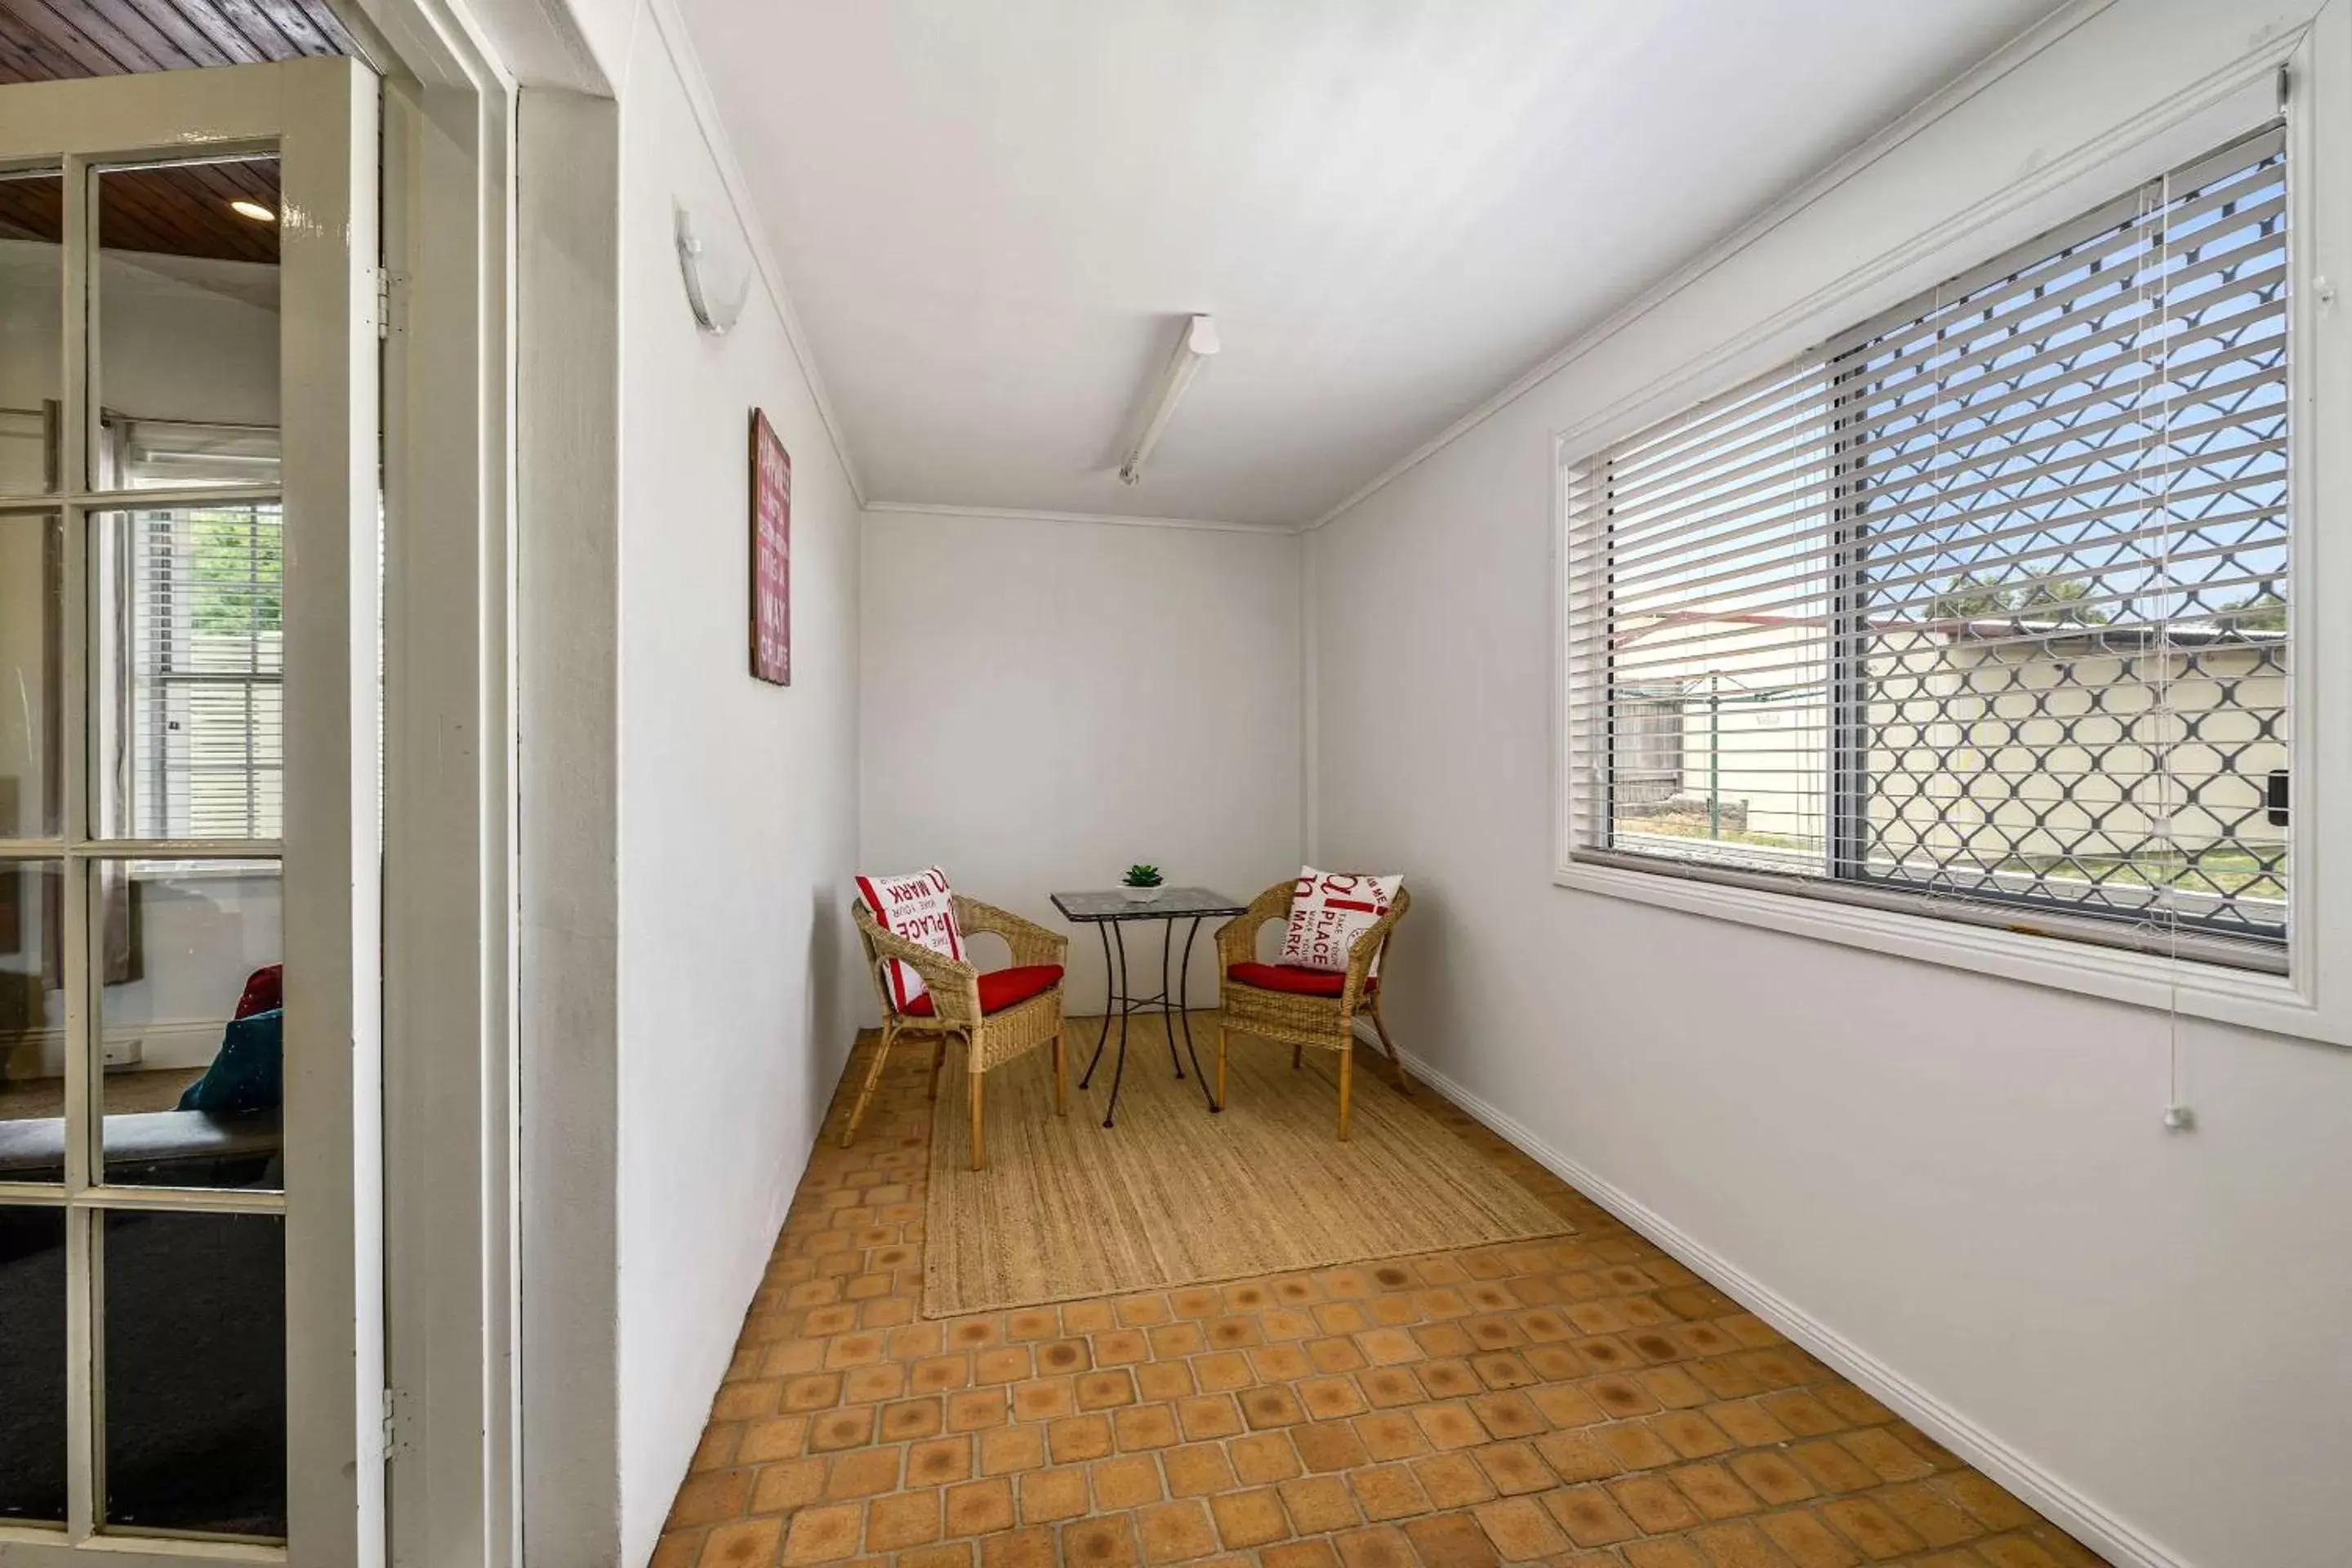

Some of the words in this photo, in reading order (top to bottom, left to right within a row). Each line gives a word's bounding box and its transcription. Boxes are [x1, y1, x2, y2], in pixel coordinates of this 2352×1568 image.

[887, 880, 932, 904] MARK
[896, 912, 946, 940] PLACE
[1285, 910, 1307, 957] MARK
[1335, 912, 1348, 935] TAKE
[1312, 911, 1335, 965] PLACE
